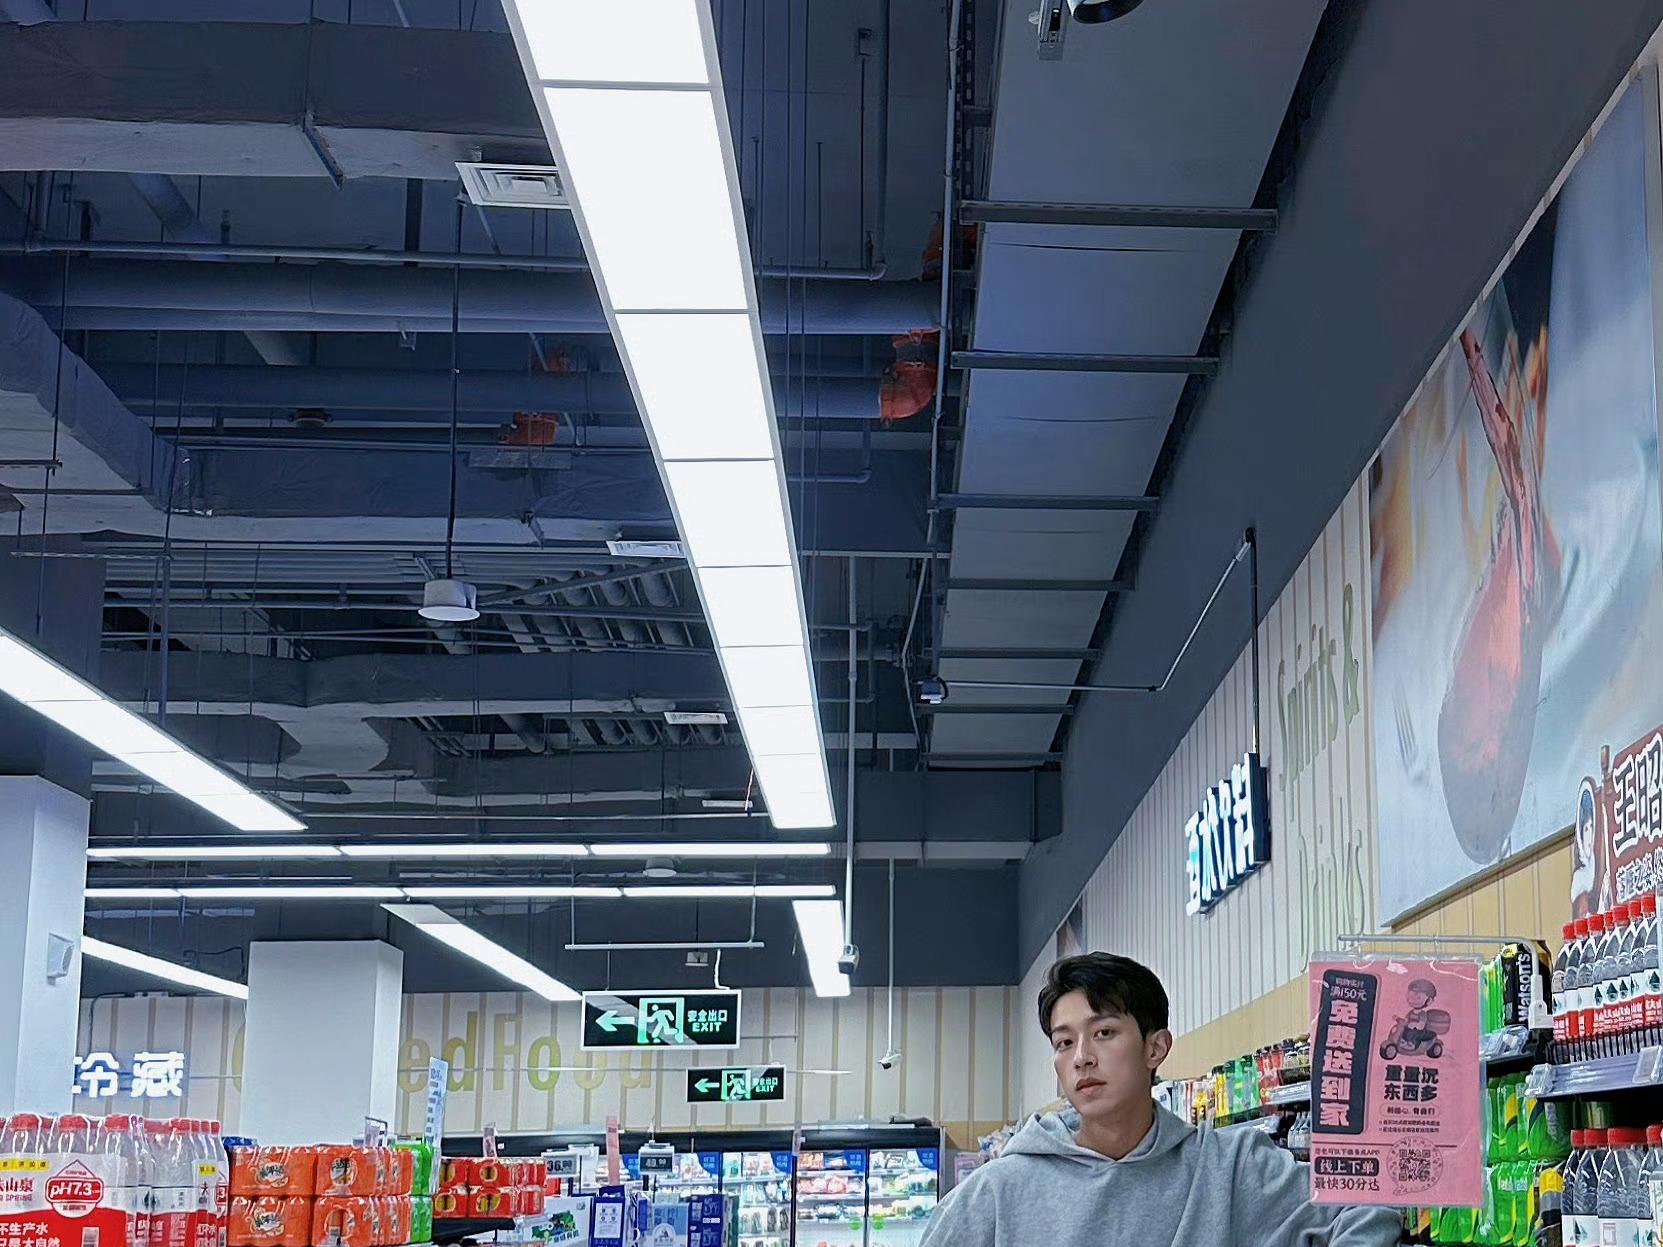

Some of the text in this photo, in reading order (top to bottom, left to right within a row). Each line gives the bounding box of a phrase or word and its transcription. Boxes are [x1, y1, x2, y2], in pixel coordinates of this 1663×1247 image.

[1343, 583, 1359, 726] &
[687, 1009, 728, 1022] 安全出口
[692, 1022, 722, 1032] EXIT
[1320, 1000, 1358, 1126] 免费送到家
[72, 1051, 185, 1098] 冷藏
[755, 1085, 774, 1093] EXIT
[1384, 1083, 1437, 1101] 东西多
[1320, 1158, 1375, 1175] 线上下单
[1314, 1177, 1380, 1192] 最快30分达
